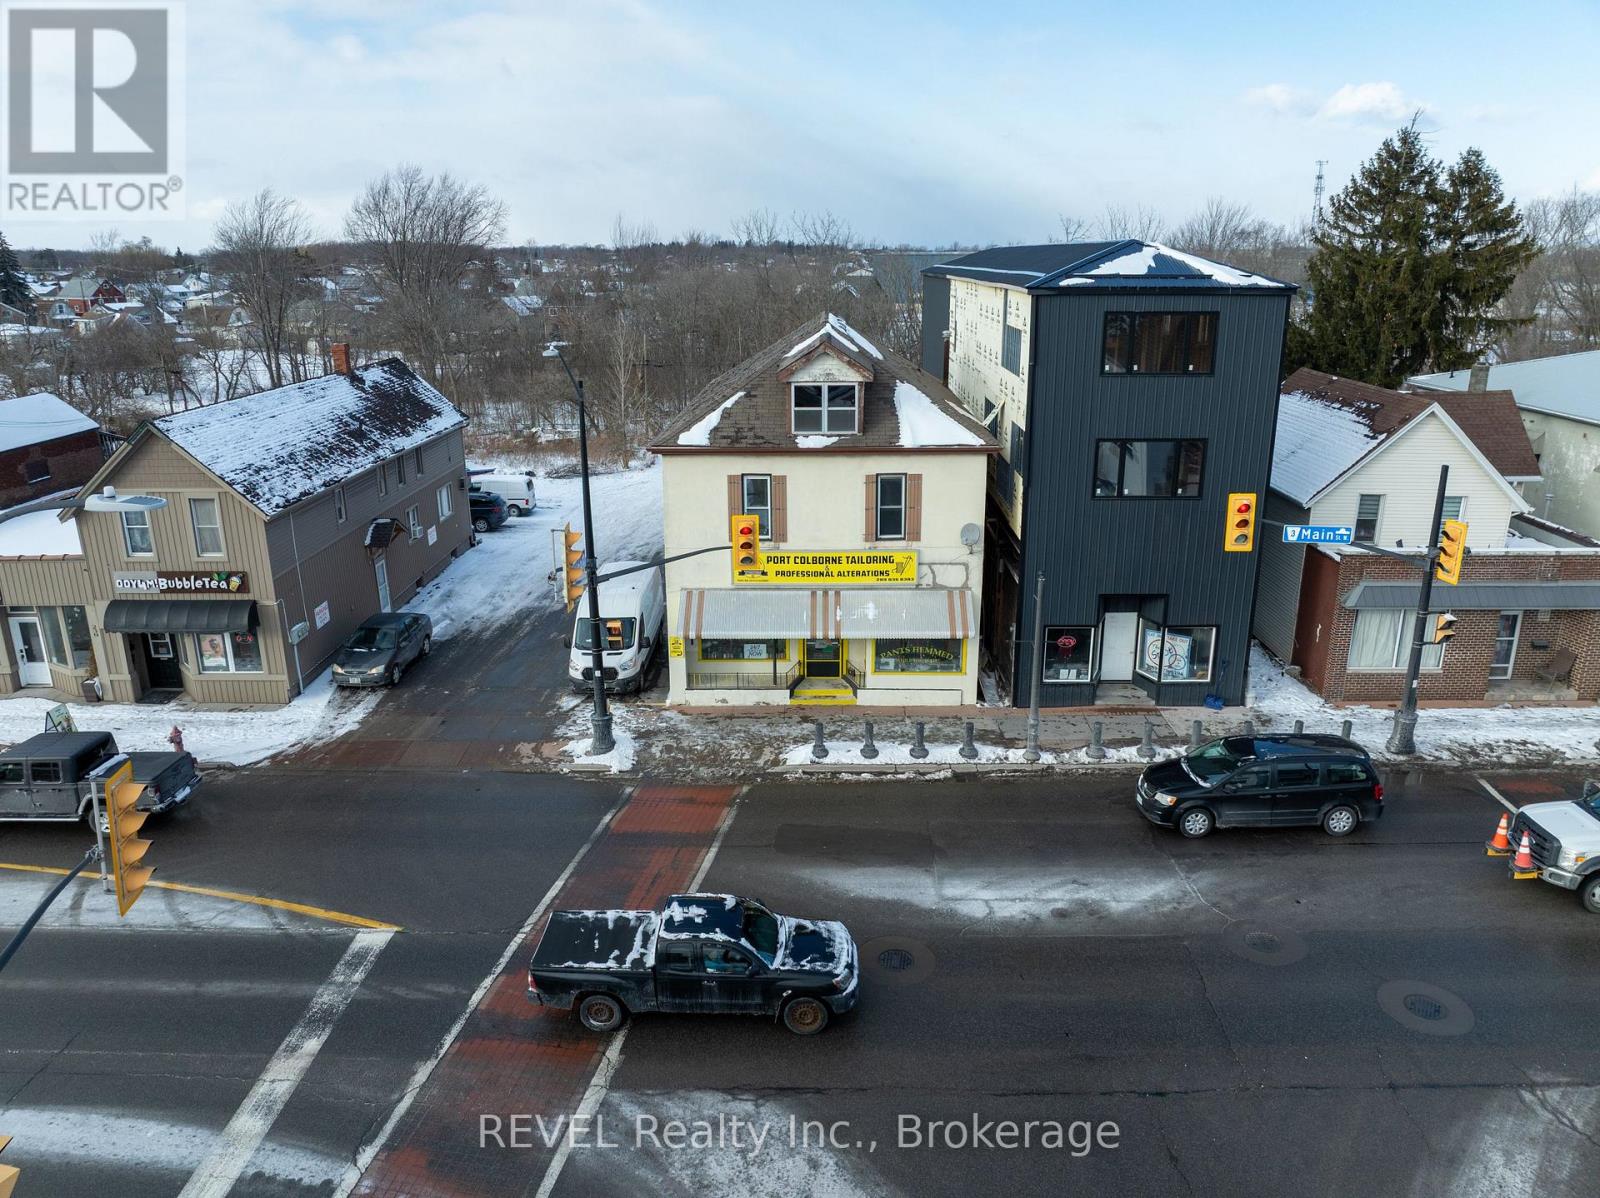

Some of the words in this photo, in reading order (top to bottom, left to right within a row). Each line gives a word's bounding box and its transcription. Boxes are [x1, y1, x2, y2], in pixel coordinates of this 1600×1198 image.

[1301, 528, 1334, 540] Main
[766, 555, 791, 565] PORT
[793, 555, 843, 565] COLBORNE
[846, 555, 895, 564] TAILORING
[775, 570, 835, 578] PROFESSIONAL
[837, 569, 890, 577] ALTERATIONS
[879, 646, 911, 659] PANTS
[911, 646, 954, 660] HEMMED
